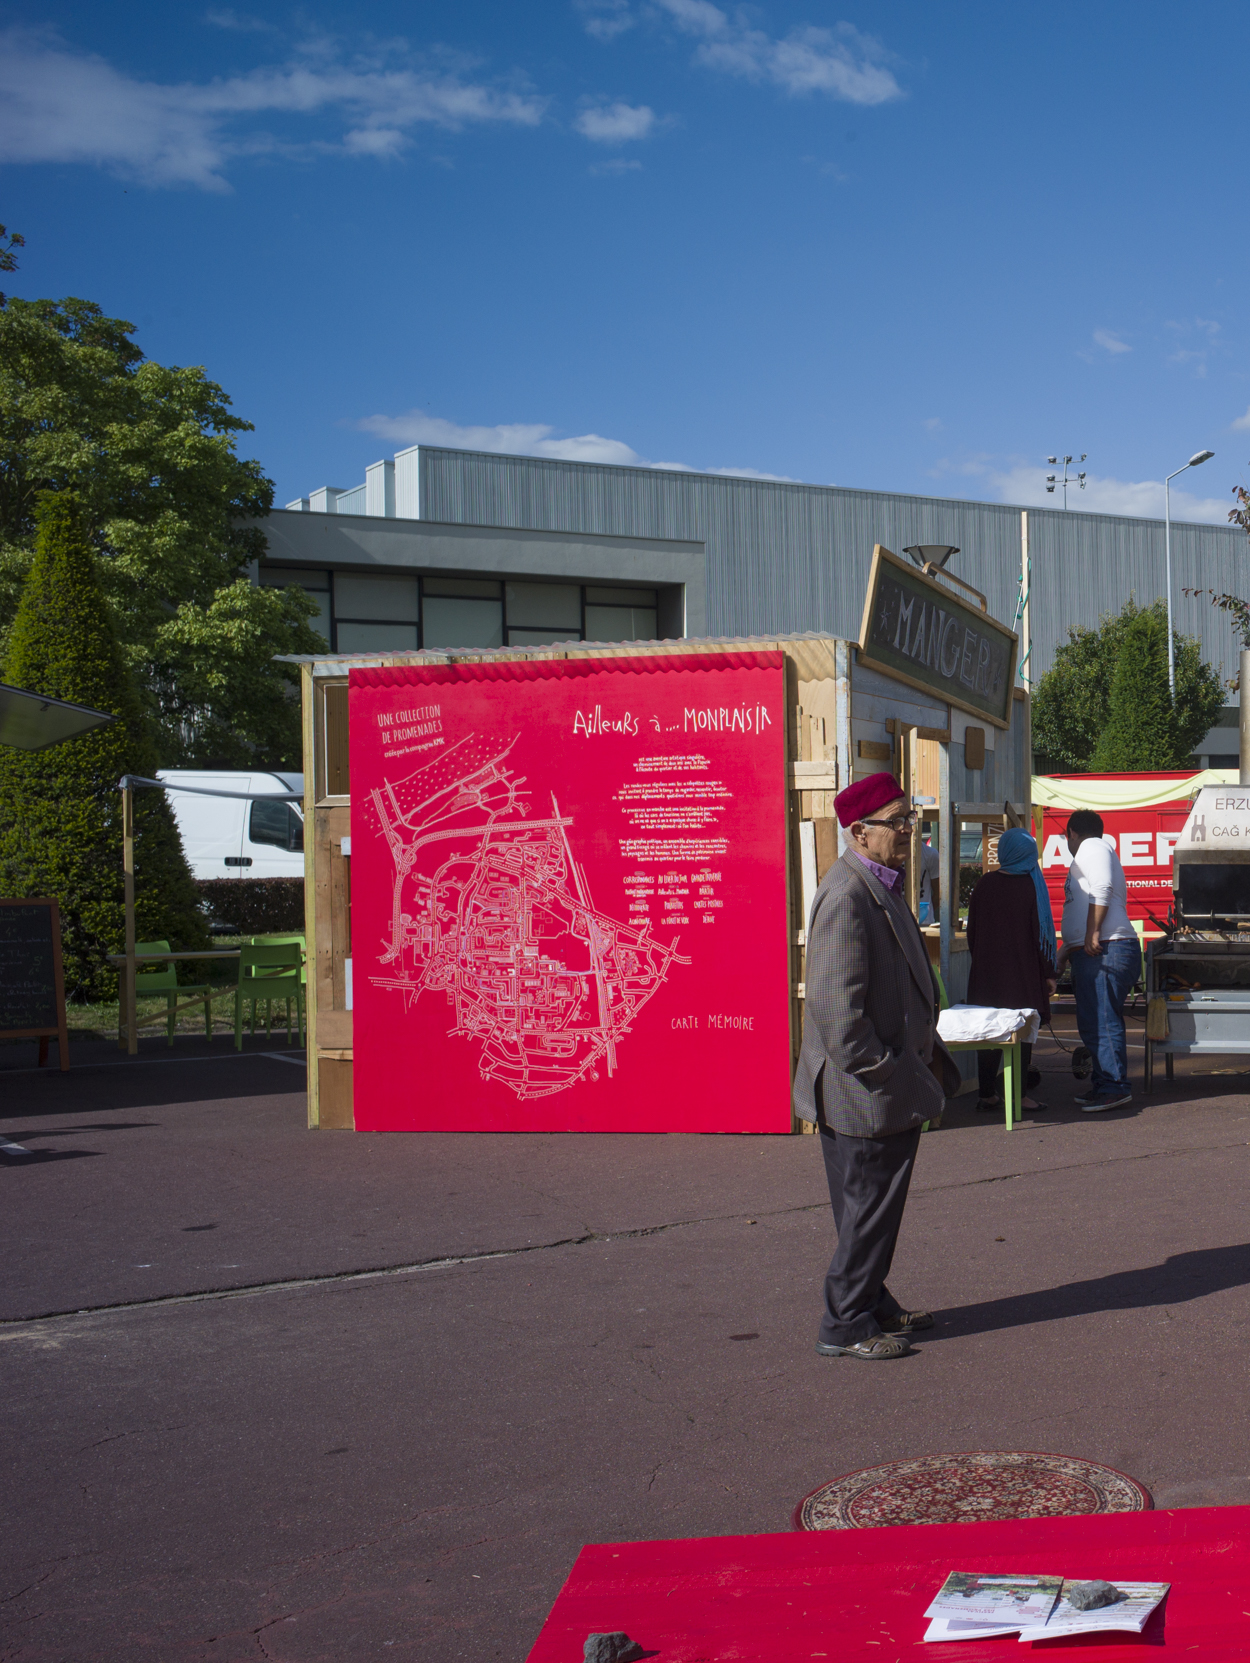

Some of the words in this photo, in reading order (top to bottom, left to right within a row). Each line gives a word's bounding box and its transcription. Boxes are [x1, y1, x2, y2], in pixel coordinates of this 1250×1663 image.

[893, 591, 991, 697] MANGER
[377, 713, 394, 728] UNE
[396, 704, 440, 723] COLLECTION
[382, 731, 391, 744] DE
[393, 720, 443, 742] PROMENADES
[1212, 824, 1240, 837] CAĞ
[1126, 880, 1160, 889] TIONAL
[671, 1015, 698, 1030] CARTE
[708, 1013, 754, 1031] MÉMOIRE
